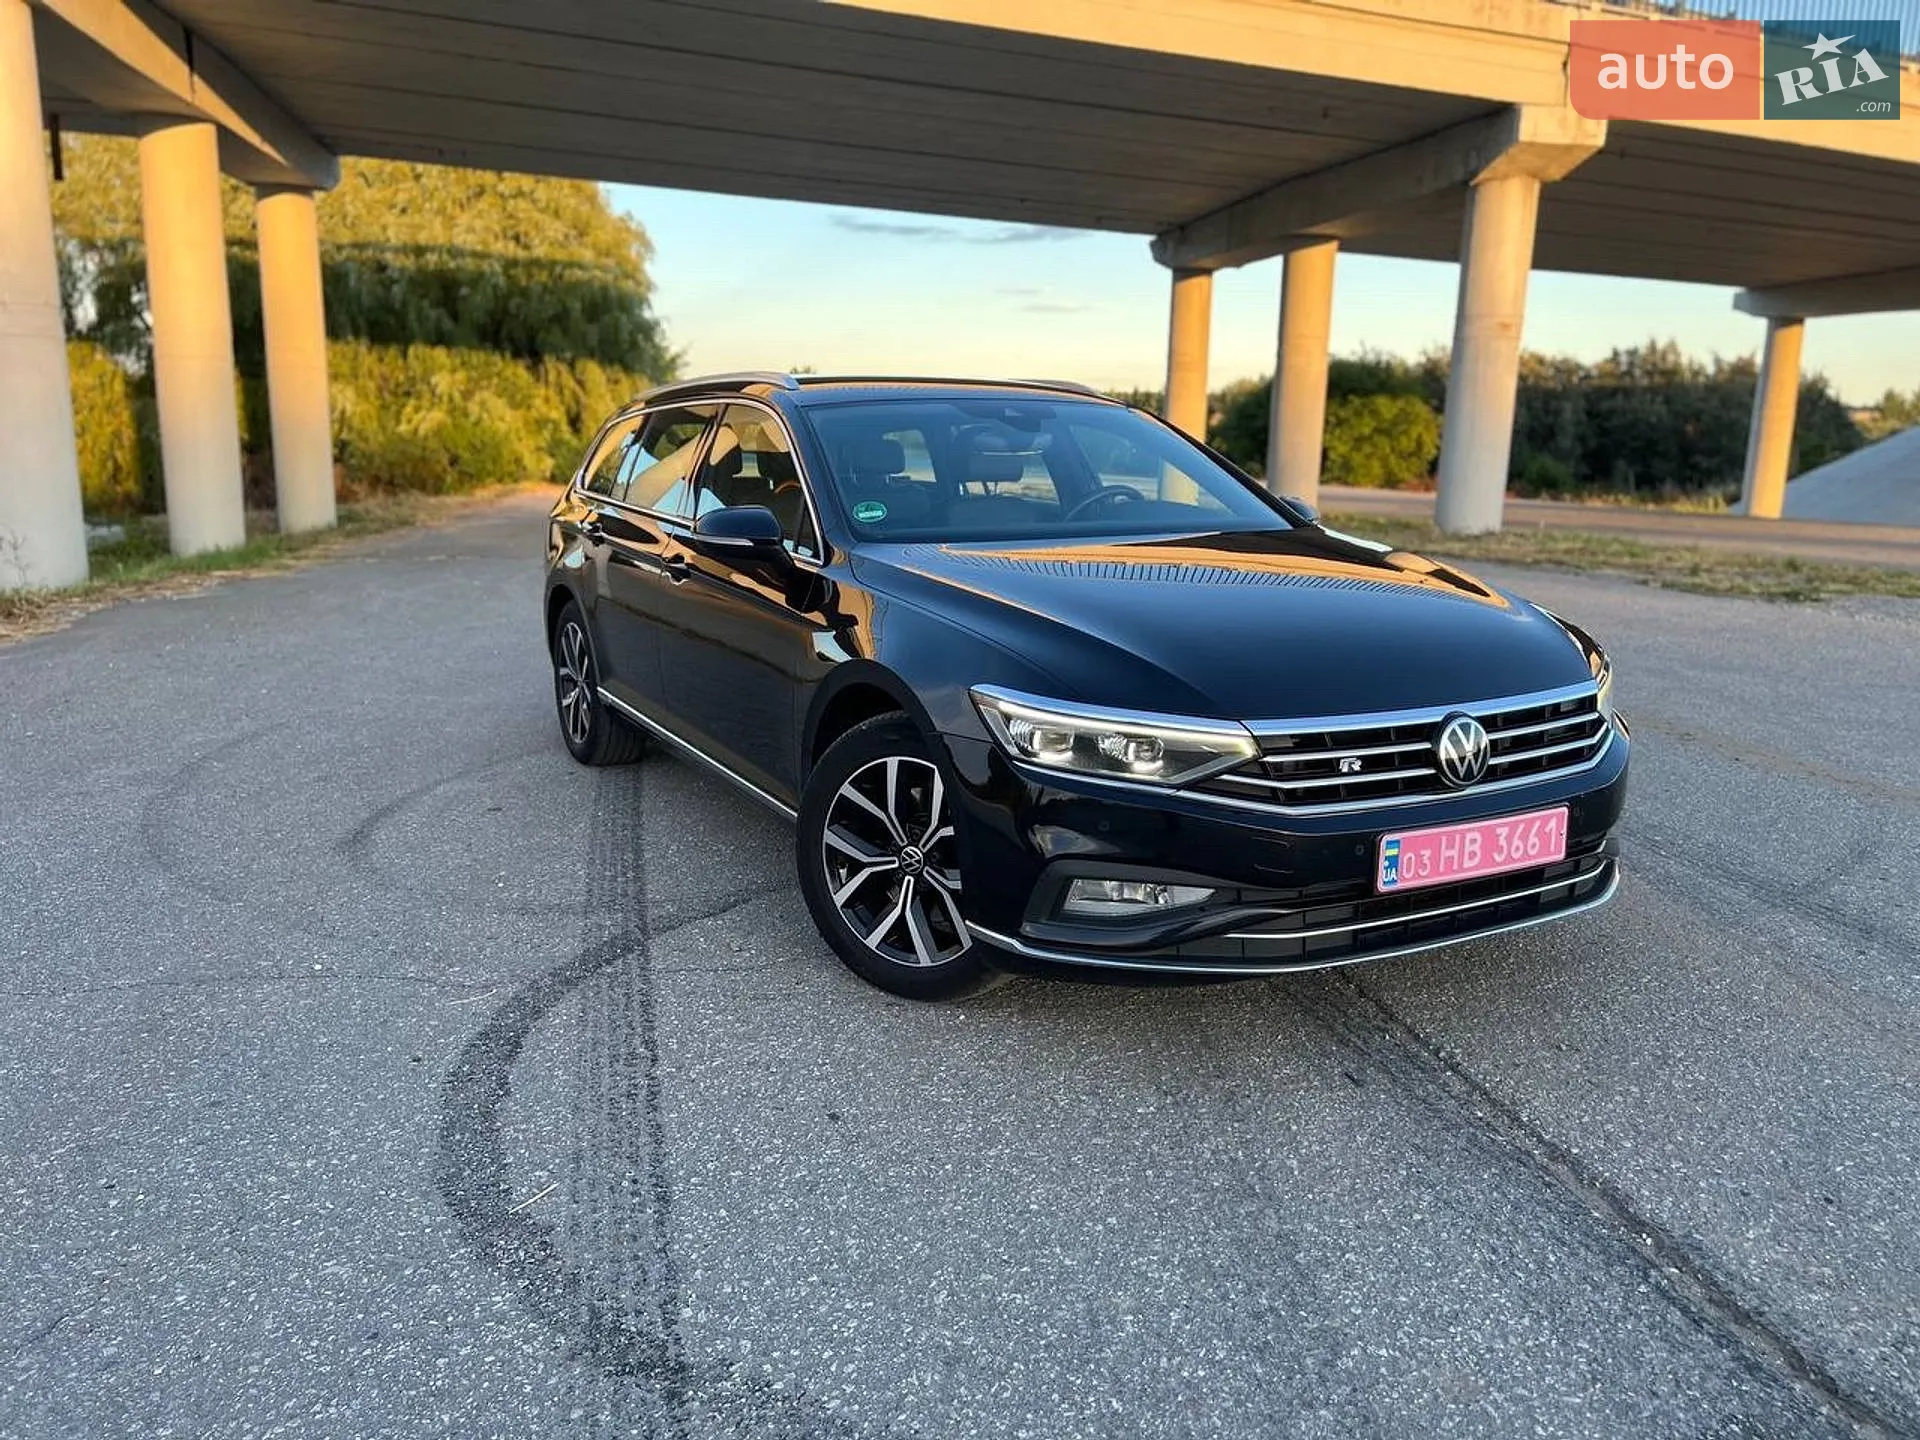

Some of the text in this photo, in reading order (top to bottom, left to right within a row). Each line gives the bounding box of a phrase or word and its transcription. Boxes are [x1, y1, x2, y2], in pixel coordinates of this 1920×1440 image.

[1402, 816, 1557, 879] 03 HB 3661
[1383, 867, 1398, 882] UA
